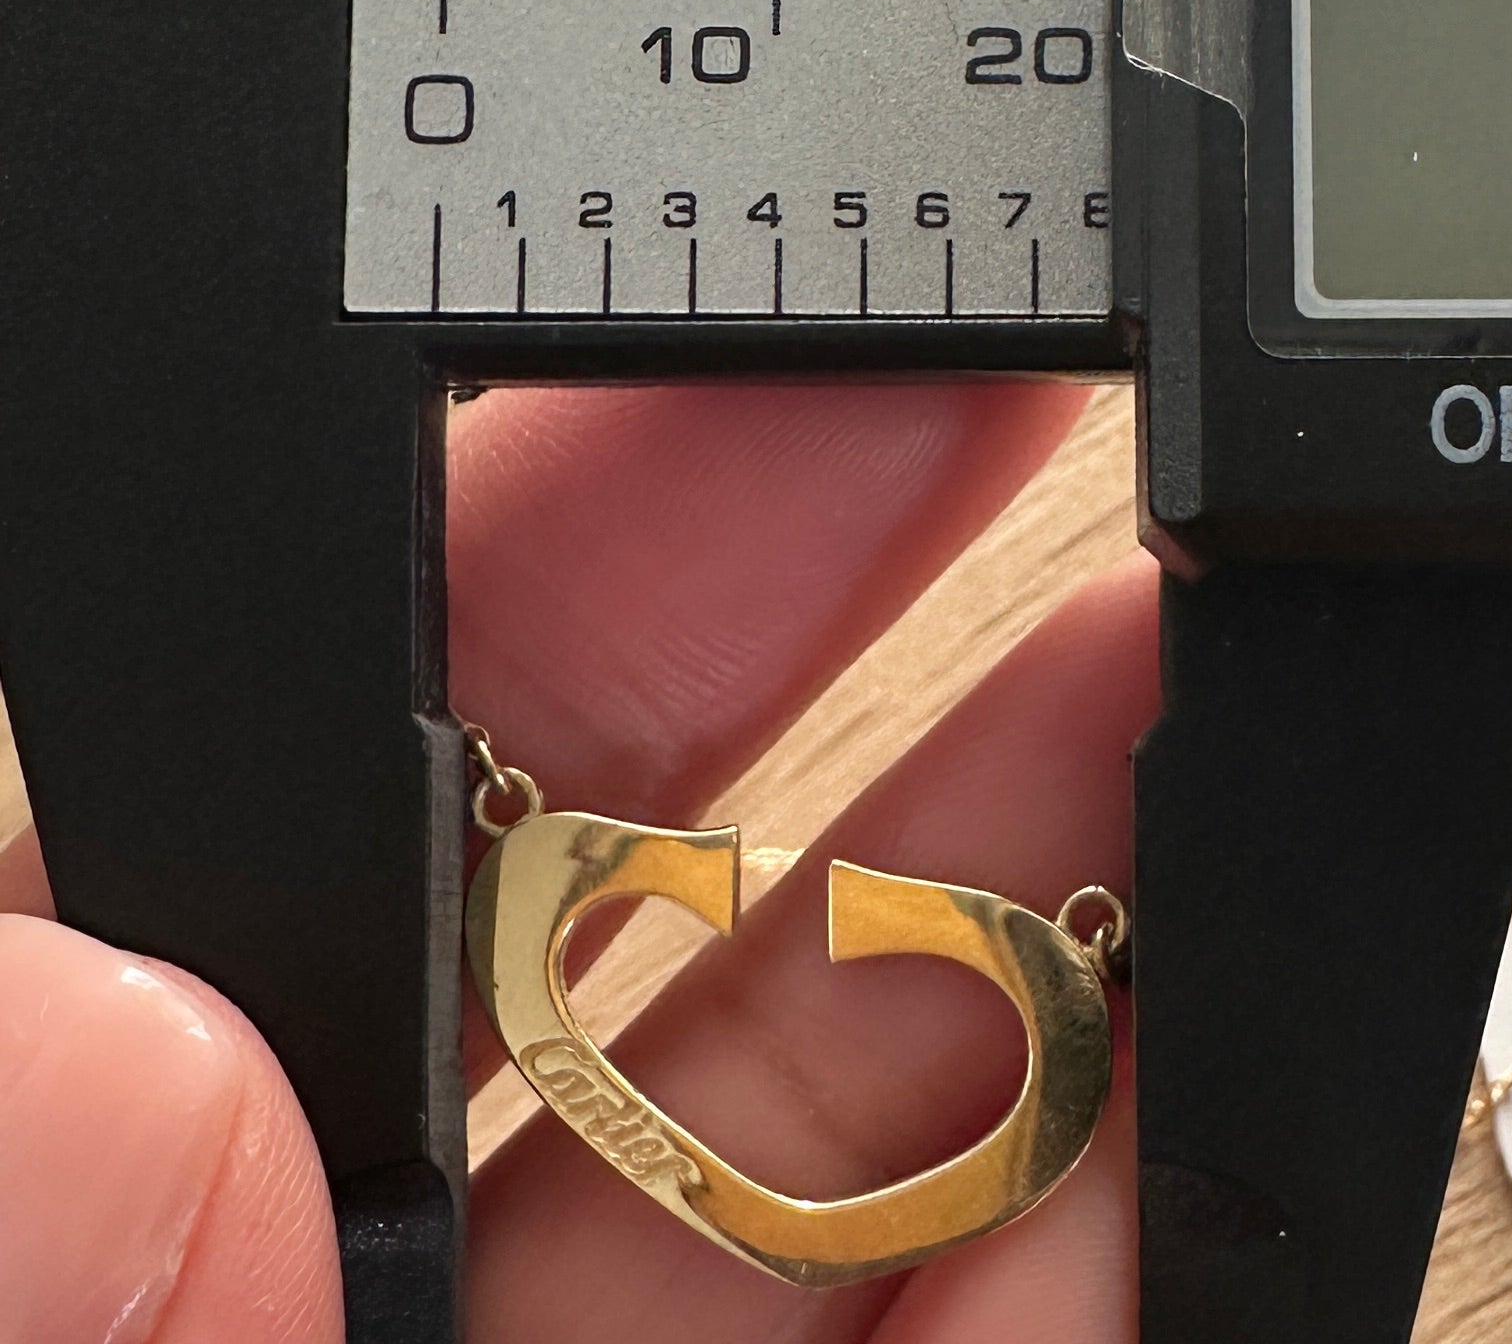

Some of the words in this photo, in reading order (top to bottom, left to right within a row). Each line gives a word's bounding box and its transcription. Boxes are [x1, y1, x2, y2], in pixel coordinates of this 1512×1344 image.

[640, 26, 751, 85] 10
[964, 26, 1094, 85] 20
[403, 74, 475, 145] 0
[495, 190, 518, 229] 1
[578, 191, 614, 229] 2
[661, 191, 698, 229] 3
[745, 191, 783, 229] 4
[832, 191, 868, 229] 5
[914, 191, 951, 229] 6
[1000, 191, 1033, 229] 7
